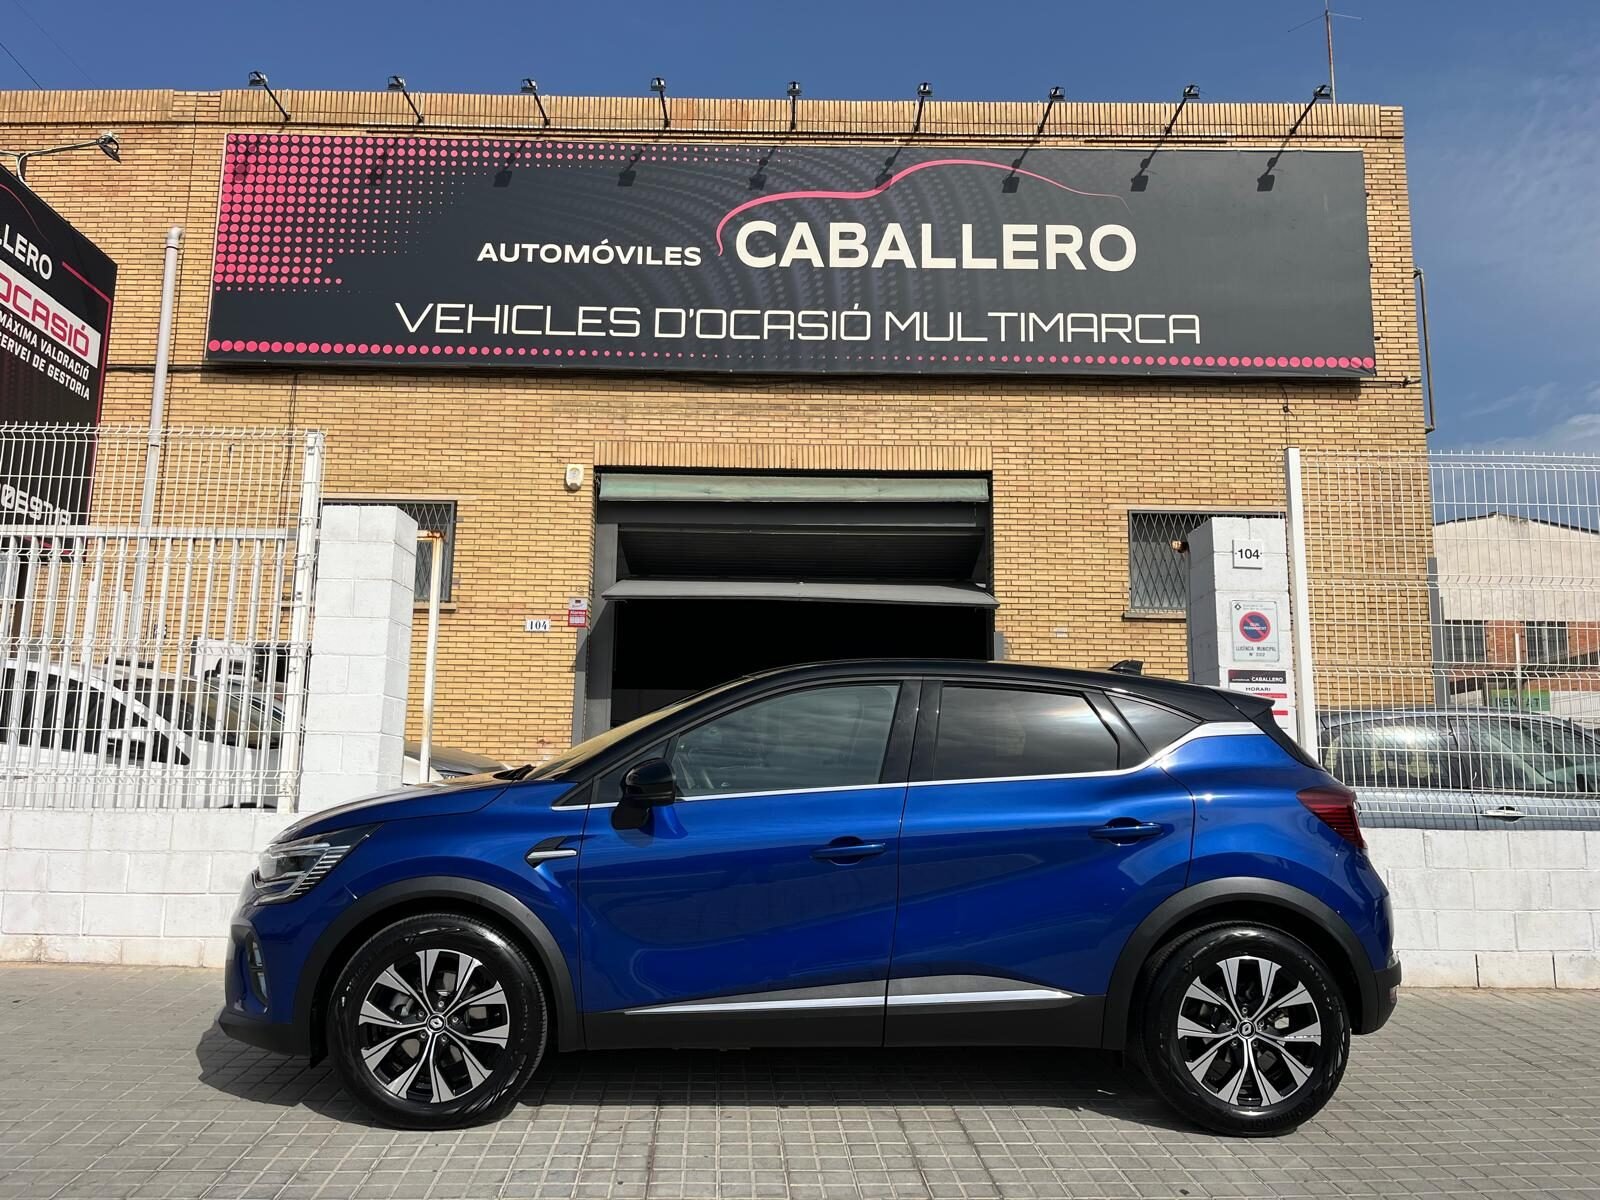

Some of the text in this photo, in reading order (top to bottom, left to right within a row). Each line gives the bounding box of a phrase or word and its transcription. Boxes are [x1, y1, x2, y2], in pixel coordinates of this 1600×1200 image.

[0, 223, 53, 280] LERO
[477, 220, 1137, 272] AUTOMÓVILES CABALLERO
[394, 302, 1201, 345] VEHICLES D'OCASIÓ MULTIMARCA
[0, 332, 90, 401] ERVEI DE GESTORIA
[40, 338, 90, 380] VALORACIÓ
[1238, 548, 1261, 560] 104
[530, 620, 547, 630] 104
